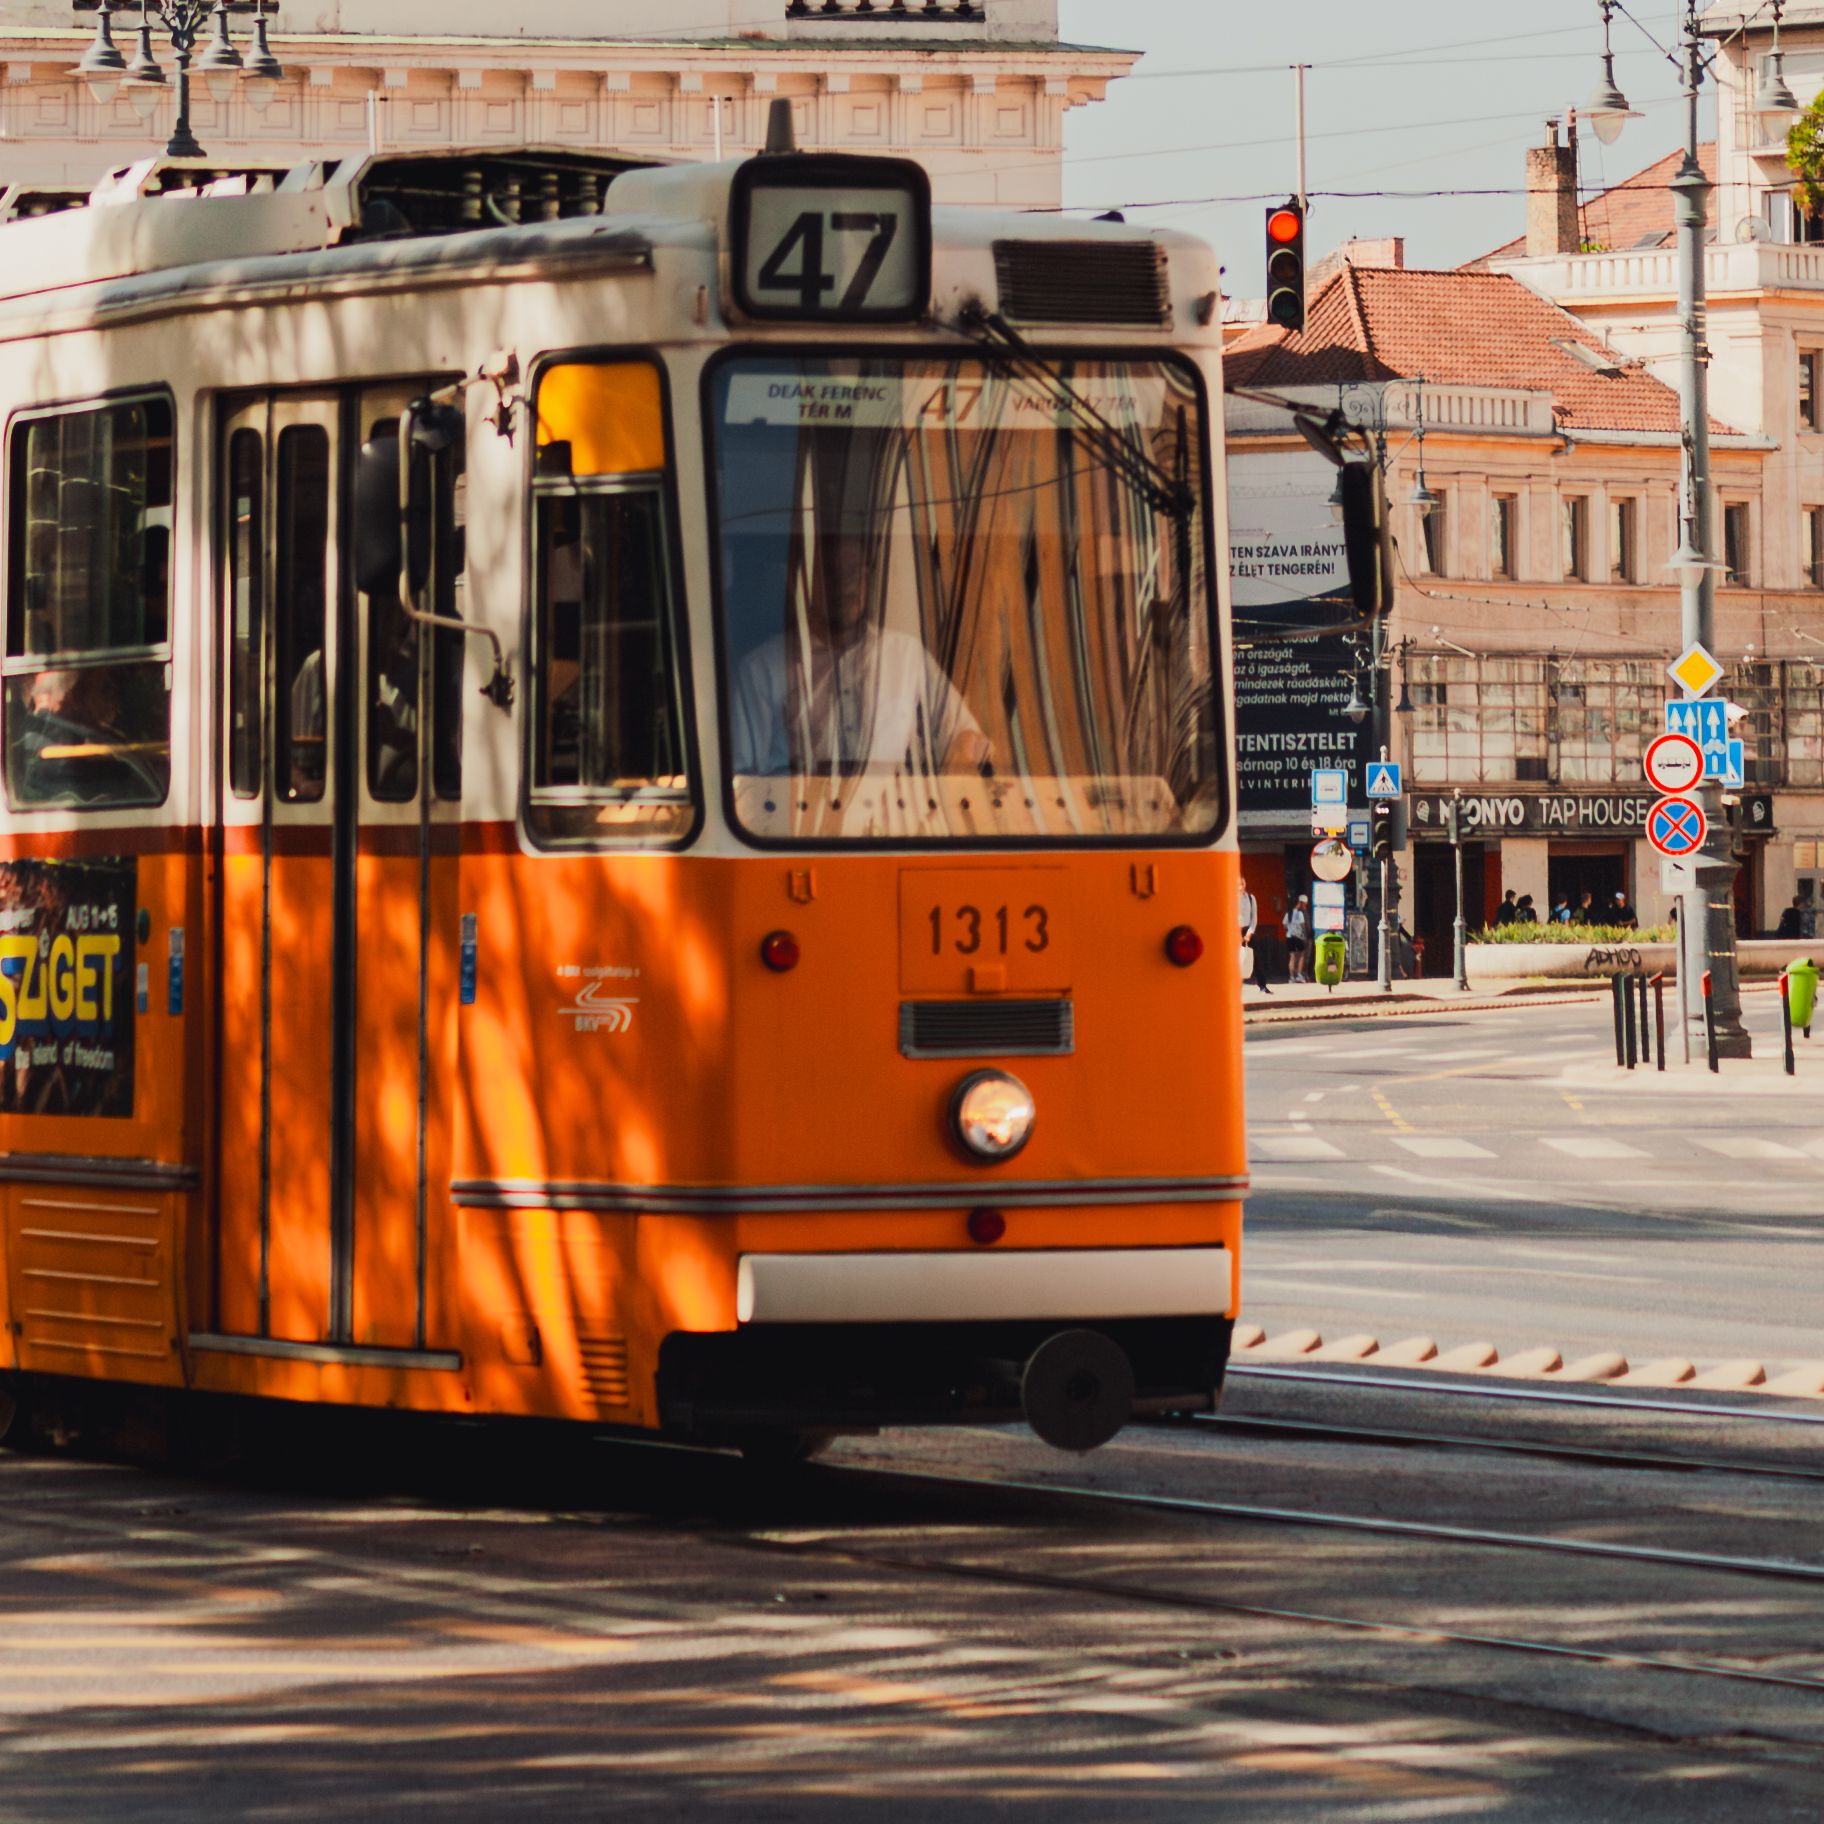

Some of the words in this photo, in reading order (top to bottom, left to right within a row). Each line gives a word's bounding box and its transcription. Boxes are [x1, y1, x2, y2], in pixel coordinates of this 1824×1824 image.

[757, 210, 898, 309] 47
[767, 382, 816, 400] DEÁK
[820, 384, 887, 402] FERENC
[798, 402, 829, 419] TÉR
[834, 404, 853, 419] M
[920, 384, 983, 423] 47
[1256, 544, 1298, 558] SZAVA
[1238, 561, 1265, 578] ÉLET
[1267, 560, 1335, 576] TENGERÉN!
[1247, 647, 1294, 662] országát
[1233, 665, 1246, 675] az
[1234, 677, 1285, 689] mindezek
[1287, 677, 1348, 689] ráadásként
[1235, 694, 1288, 708] gadatnak
[1289, 692, 1319, 707] majd
[1285, 757, 1298, 770] 10
[1301, 756, 1316, 770] és
[1319, 756, 1331, 770] 18
[1334, 756, 1357, 770] óra
[927, 904, 1050, 955] 1313
